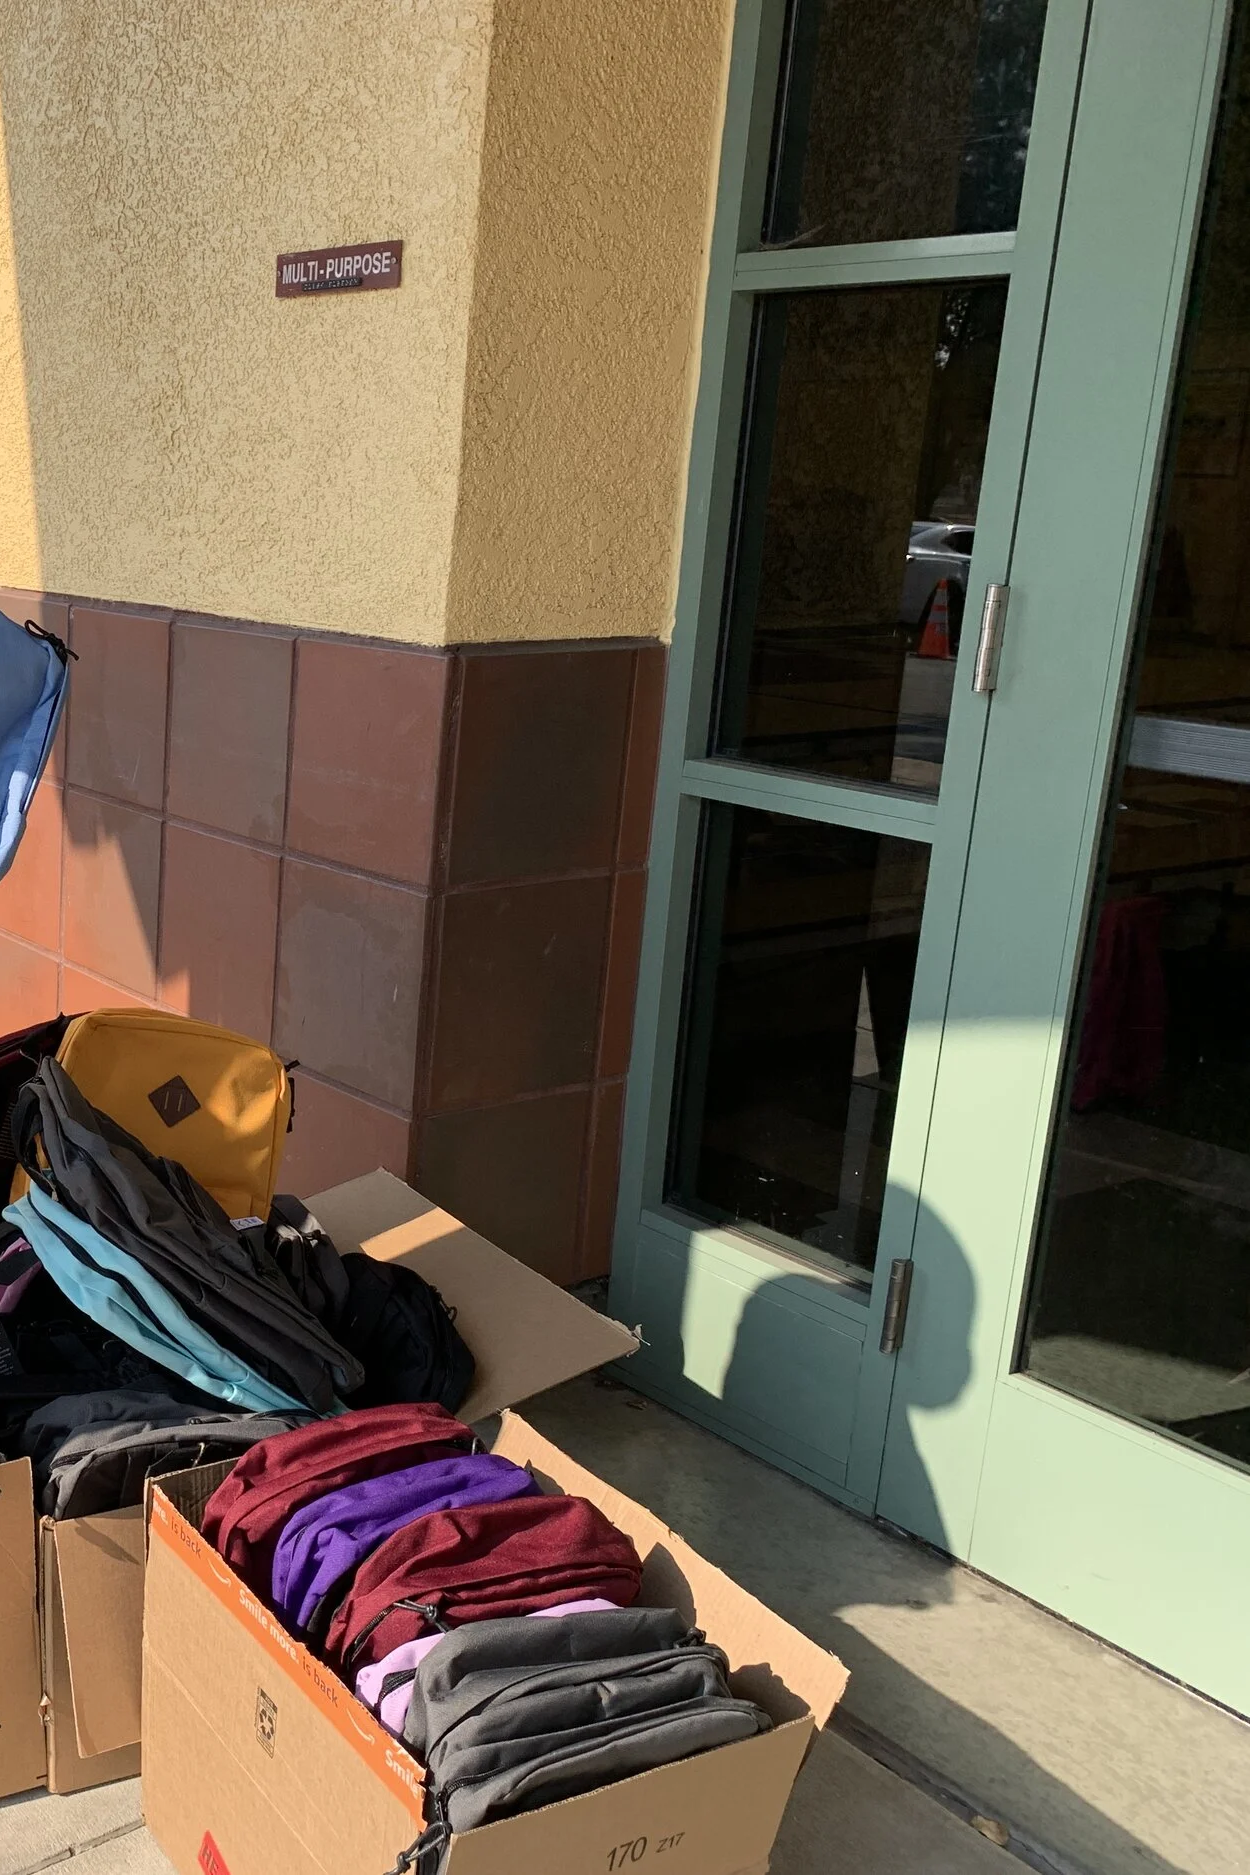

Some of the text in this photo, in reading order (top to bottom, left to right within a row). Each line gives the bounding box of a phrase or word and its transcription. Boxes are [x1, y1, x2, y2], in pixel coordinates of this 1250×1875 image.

[171, 1517, 179, 1534] is
[180, 1525, 202, 1559] back
[239, 1588, 268, 1629] Smile
[269, 1624, 299, 1665] more.
[302, 1656, 311, 1676] is
[314, 1668, 338, 1708] back
[607, 1831, 686, 1872] 170 Z17
